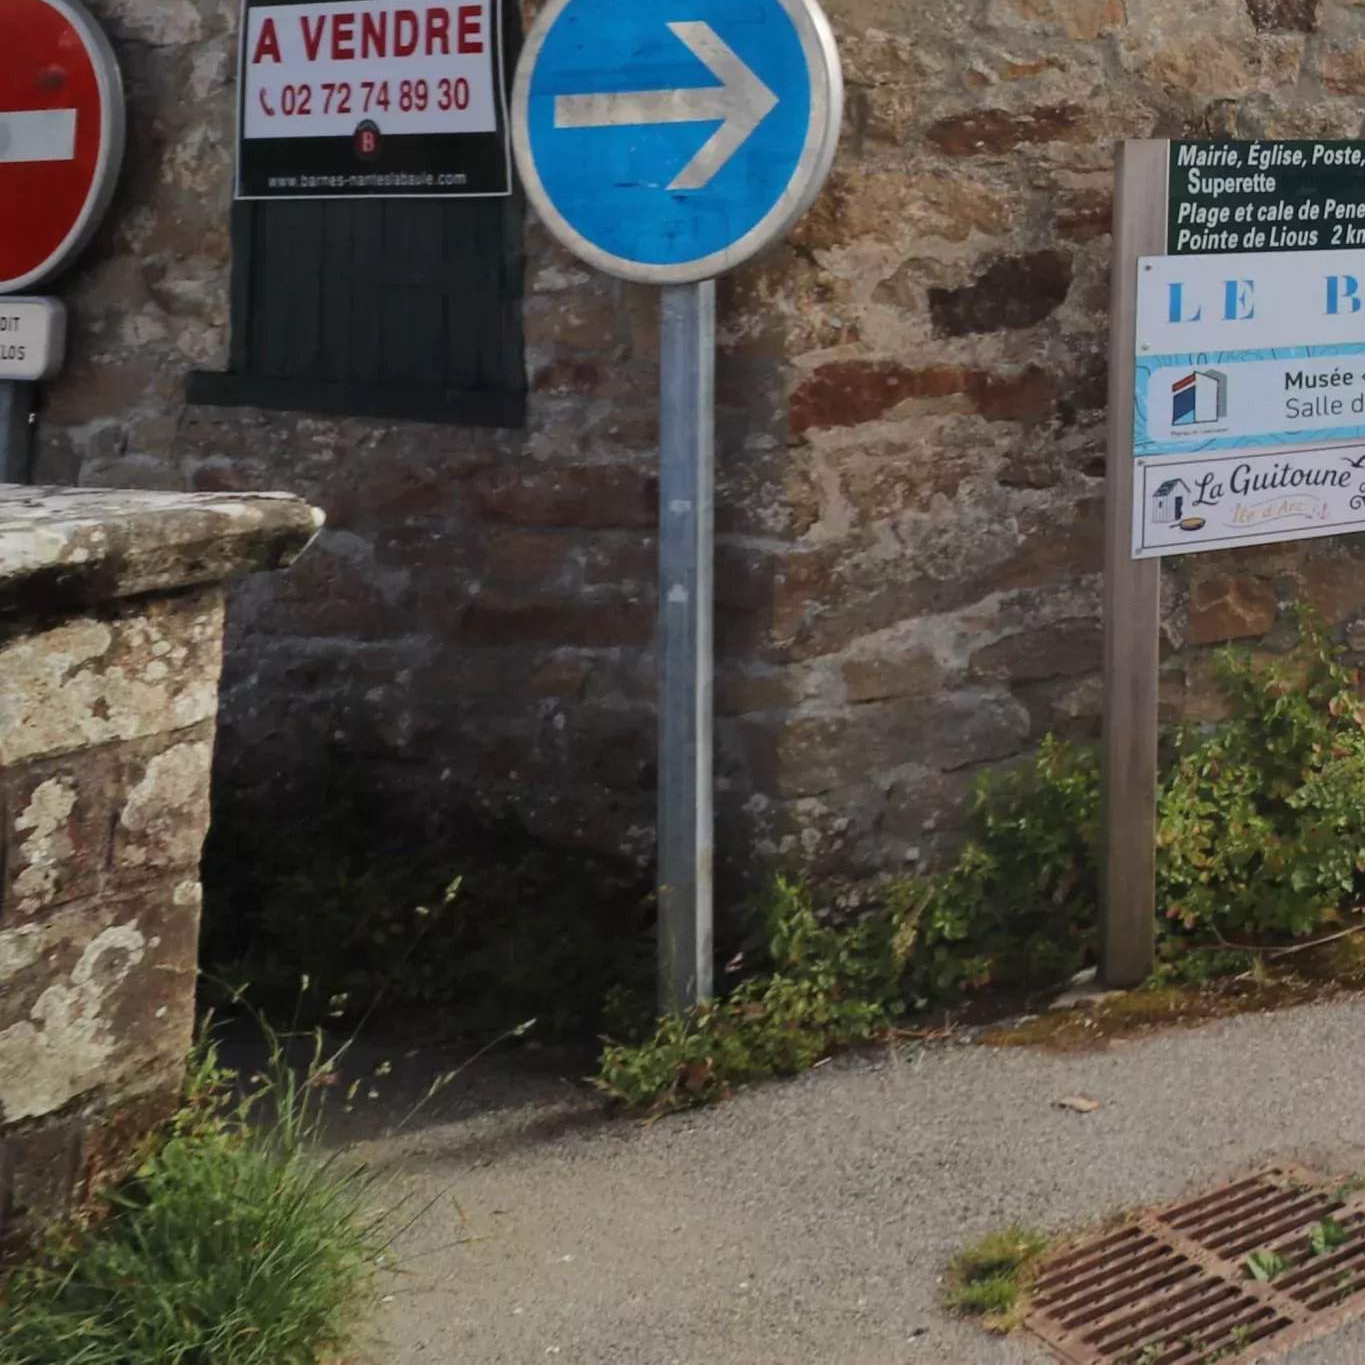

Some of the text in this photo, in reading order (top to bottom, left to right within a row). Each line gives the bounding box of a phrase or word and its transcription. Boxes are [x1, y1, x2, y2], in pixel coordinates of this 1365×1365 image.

[252, 5, 483, 64] A VENDRE
[281, 77, 470, 116] 02 72 74 89 30
[1177, 144, 1243, 168] Mairie,
[1247, 141, 1307, 170] Église,
[1187, 167, 1277, 198] Superette
[1177, 202, 1230, 228] Plage
[1234, 203, 1254, 222] et
[1257, 200, 1294, 221] cale
[1298, 199, 1320, 220] de
[1177, 229, 1239, 251] Pointe
[1243, 227, 1266, 249] de
[1269, 226, 1318, 248] Lious
[1331, 224, 1343, 245] 2
[1166, 279, 1257, 324] LE
[1284, 368, 1353, 390] Musée
[1286, 395, 1343, 419] Salle
[1192, 462, 1351, 506] La Guitoune
